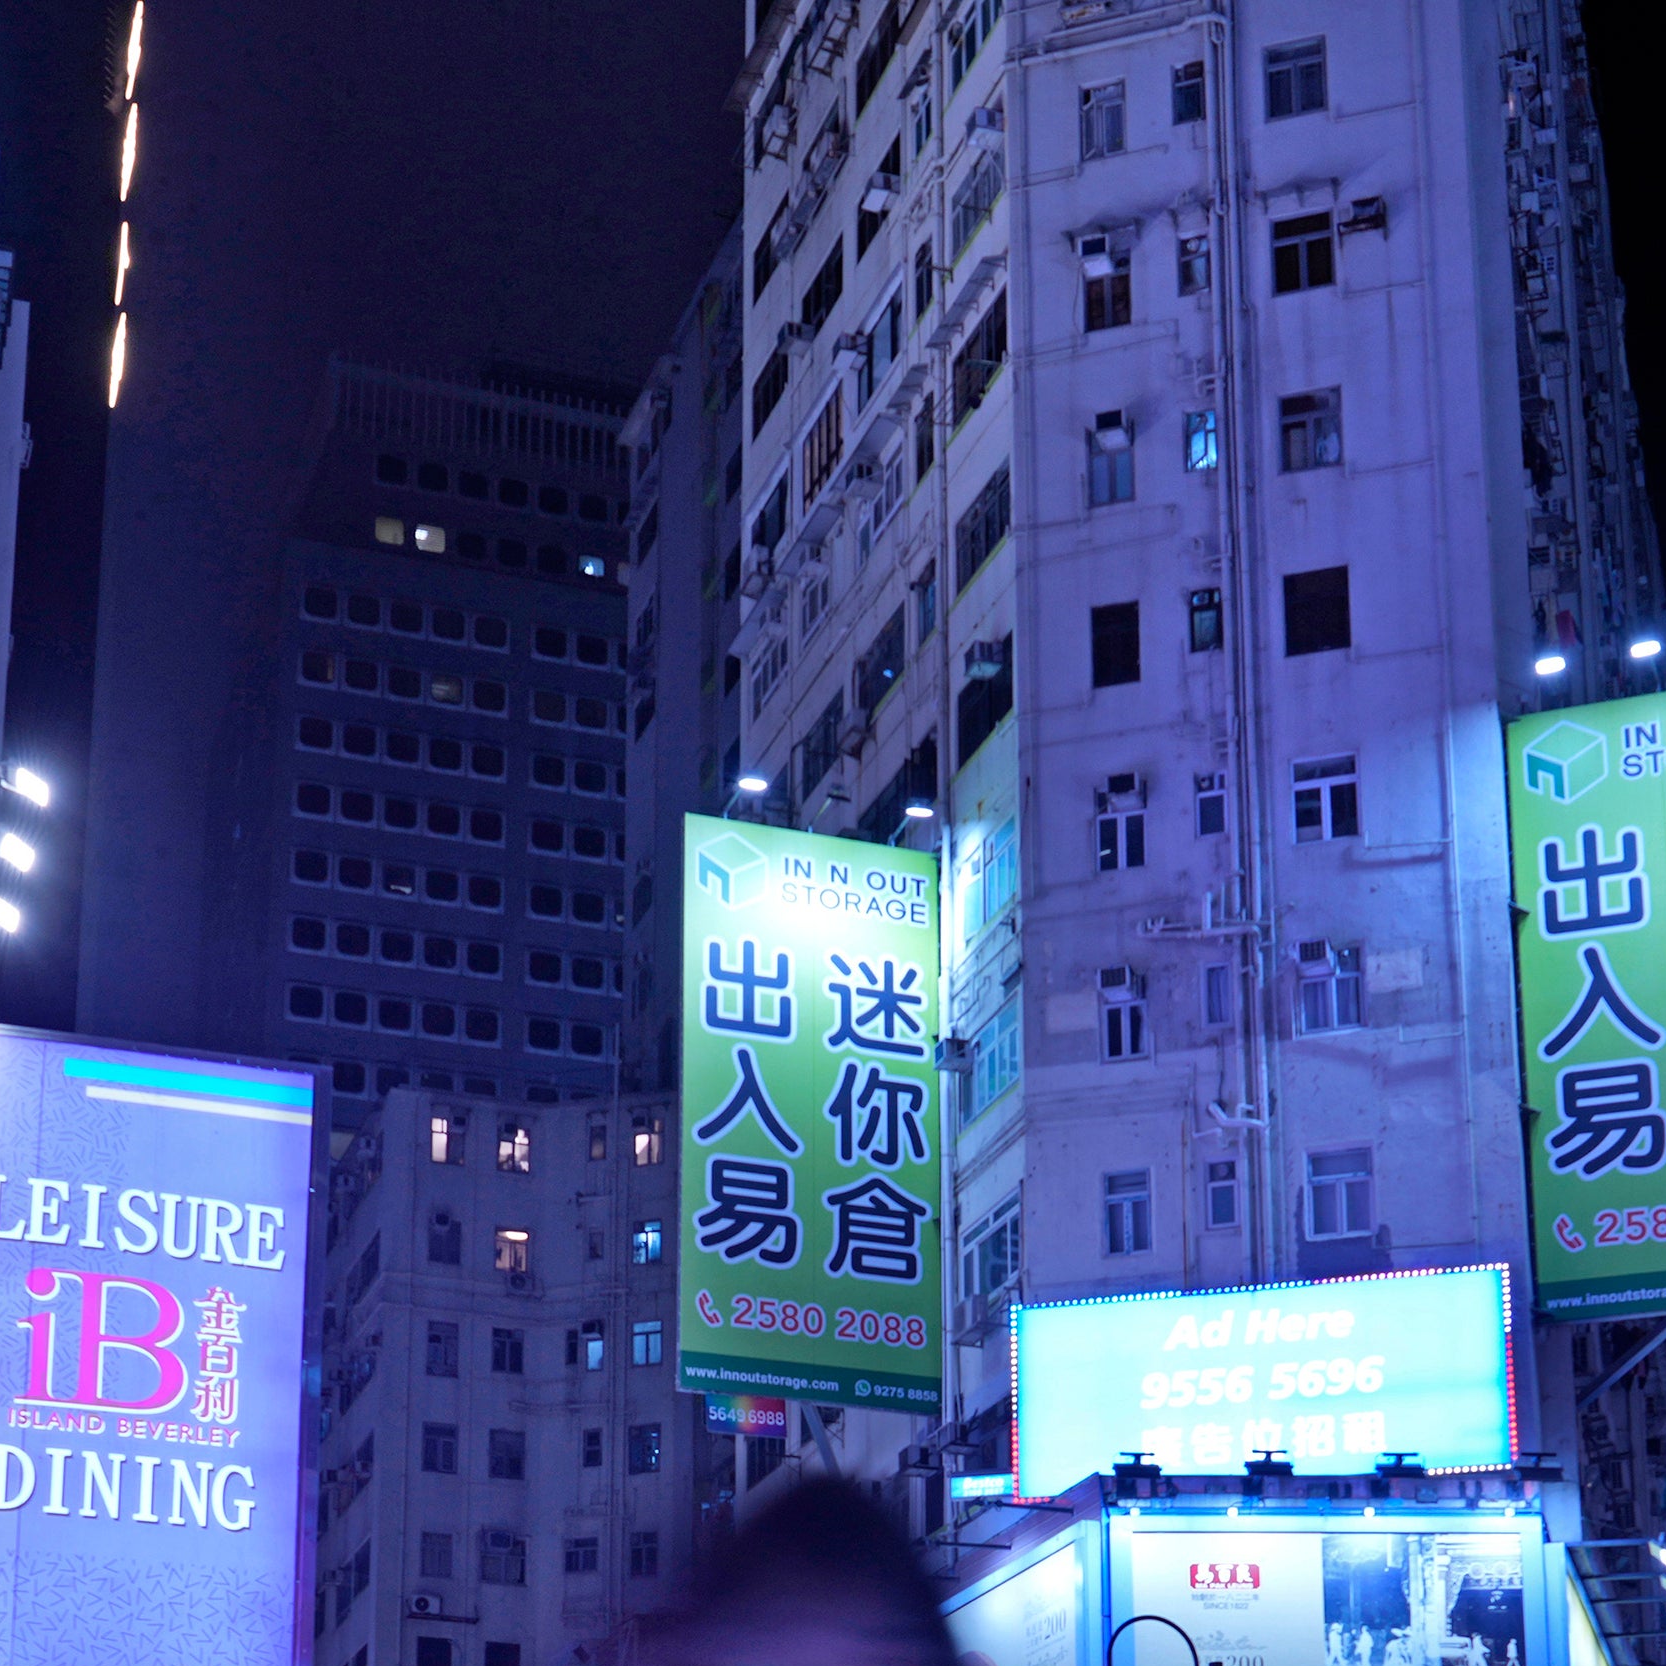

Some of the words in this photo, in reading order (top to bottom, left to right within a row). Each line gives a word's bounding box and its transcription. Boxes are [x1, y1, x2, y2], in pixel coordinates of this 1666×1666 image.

[1625, 723, 1657, 749] IN
[784, 857, 812, 880] IN
[831, 864, 849, 885] N
[866, 871, 927, 898] OUT
[782, 882, 927, 925] STORAGE
[1543, 829, 1666, 1175] 出入易
[697, 940, 800, 1264] 出入易
[827, 953, 927, 1280] 迷你倉
[15, 1267, 187, 1415] iB
[733, 1297, 824, 1336] 2580
[836, 1310, 926, 1348] 2088
[1164, 1314, 1232, 1352] Ad
[1244, 1308, 1356, 1346] Here
[194, 1286, 247, 1426] 金百利
[685, 1364, 840, 1394] www.innoutstorage.com
[872, 1383, 906, 1400] 9275
[906, 1387, 939, 1403] 8858
[1138, 1365, 1255, 1409] 9556
[1267, 1355, 1387, 1401] 5696
[7, 1407, 107, 1436] ISLAND
[116, 1416, 242, 1448] BEVERLEY
